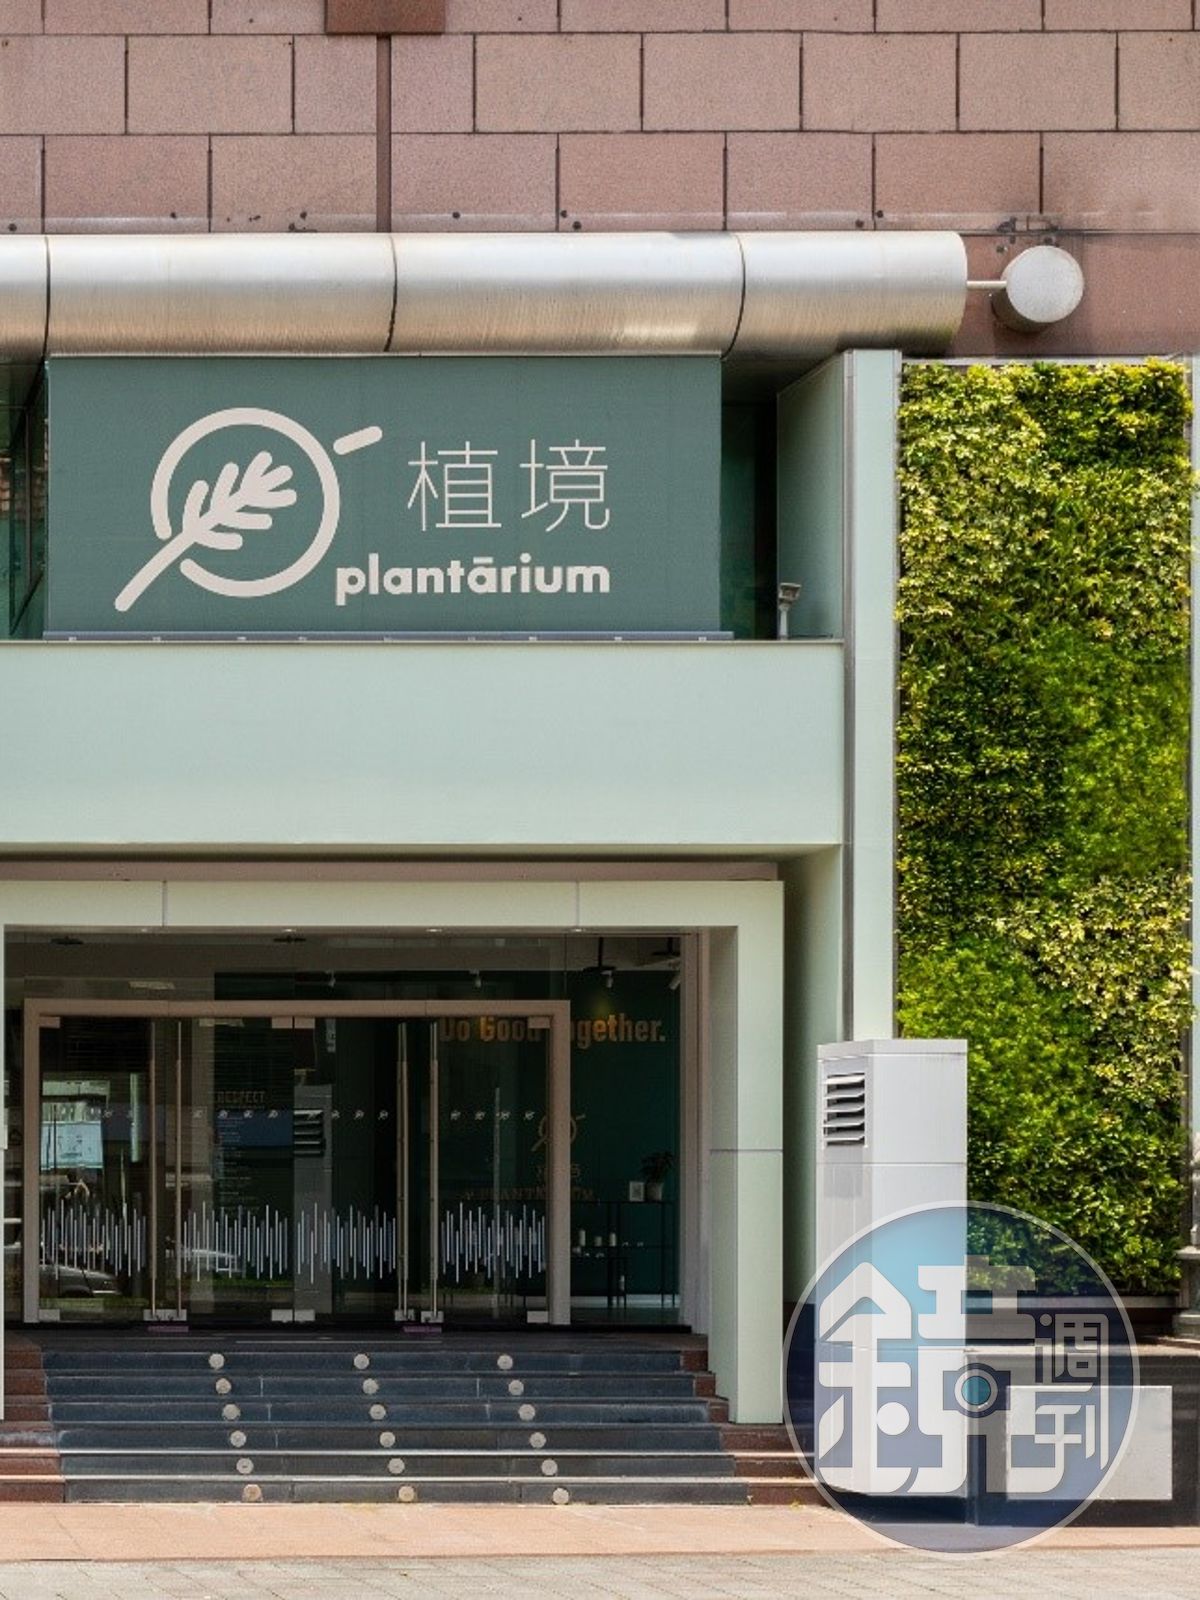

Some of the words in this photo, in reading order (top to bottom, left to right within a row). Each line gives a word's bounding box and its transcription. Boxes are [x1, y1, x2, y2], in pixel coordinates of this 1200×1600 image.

[407, 438, 611, 533] 植境
[335, 552, 611, 606] plantārium
[570, 1013, 666, 1049] gether.
